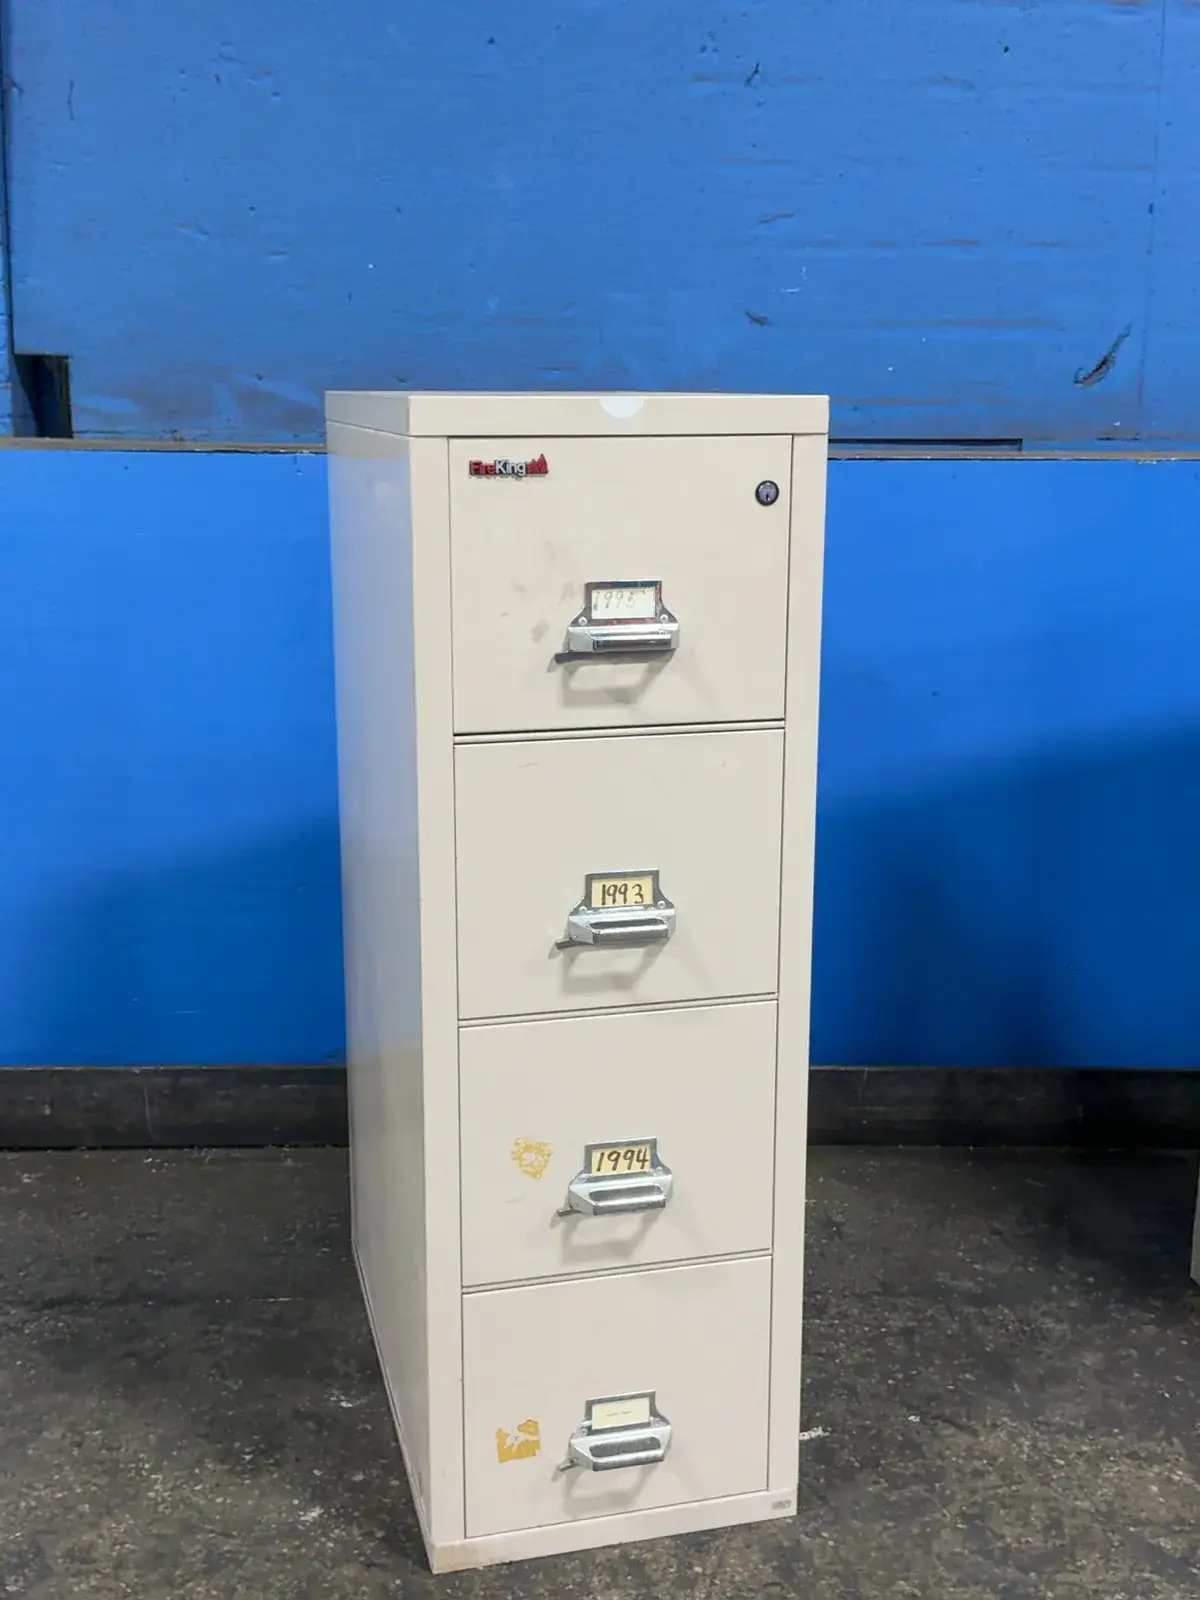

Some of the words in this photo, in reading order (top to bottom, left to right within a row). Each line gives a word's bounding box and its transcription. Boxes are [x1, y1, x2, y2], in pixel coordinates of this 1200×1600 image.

[469, 459, 527, 477] FireKing
[601, 883, 644, 905] 1993
[596, 1147, 650, 1172] 1994
